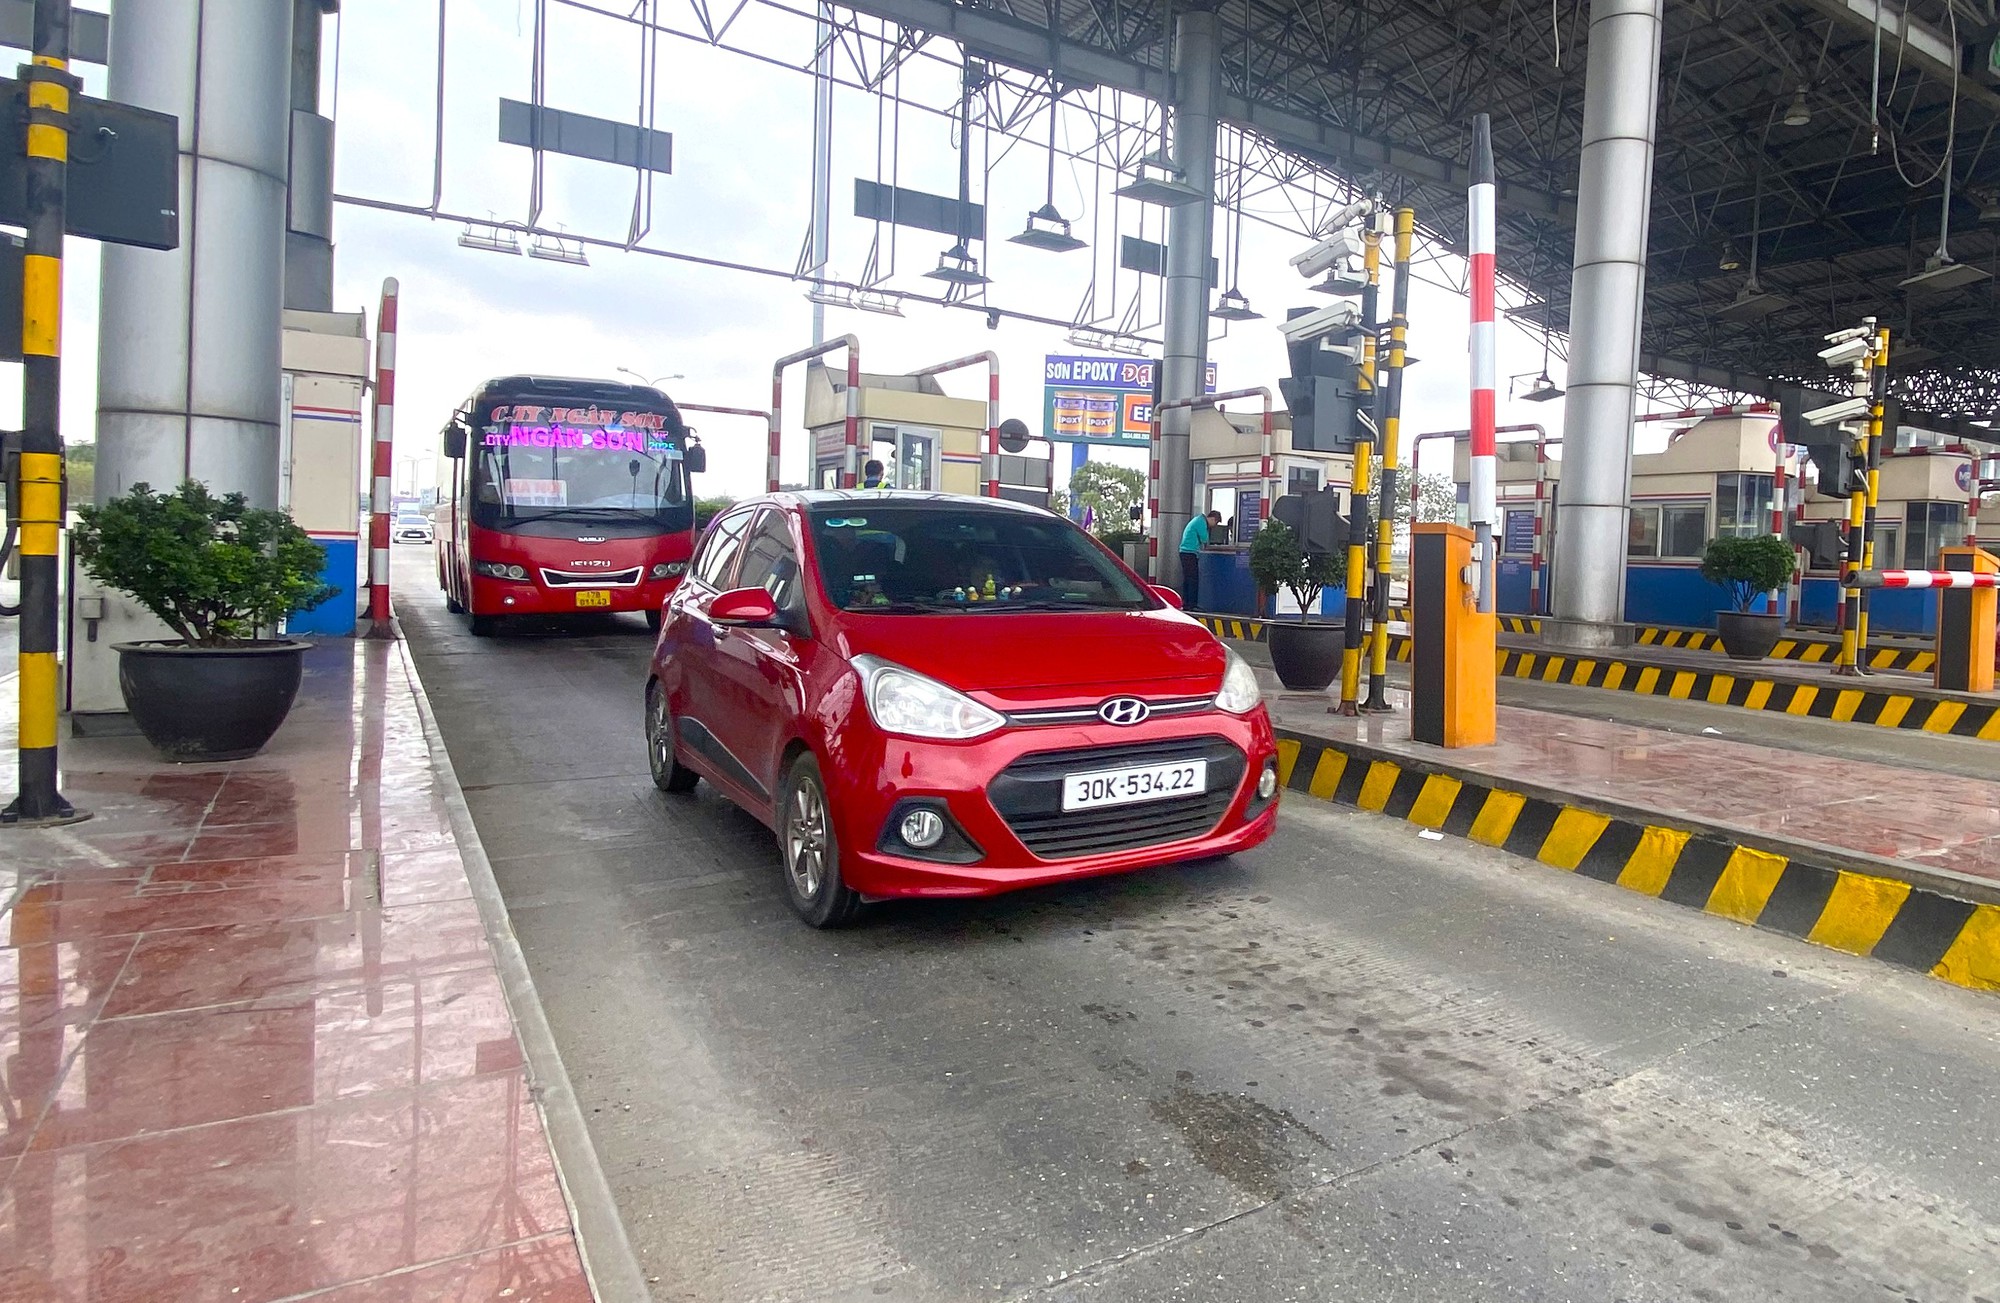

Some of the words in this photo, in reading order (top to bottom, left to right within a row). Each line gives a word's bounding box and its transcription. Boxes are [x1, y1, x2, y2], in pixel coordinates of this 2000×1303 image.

[1046, 362, 1070, 380] SƠN
[1073, 362, 1118, 382] EPOXY
[548, 404, 617, 424] NGÂN
[621, 411, 667, 429] SƠN
[1057, 416, 1082, 425] EPOXY
[1087, 418, 1112, 427] EPOXY
[509, 424, 584, 448] NGÂN
[592, 430, 643, 453] SƠN
[1078, 768, 1195, 802] 30K-534.22
